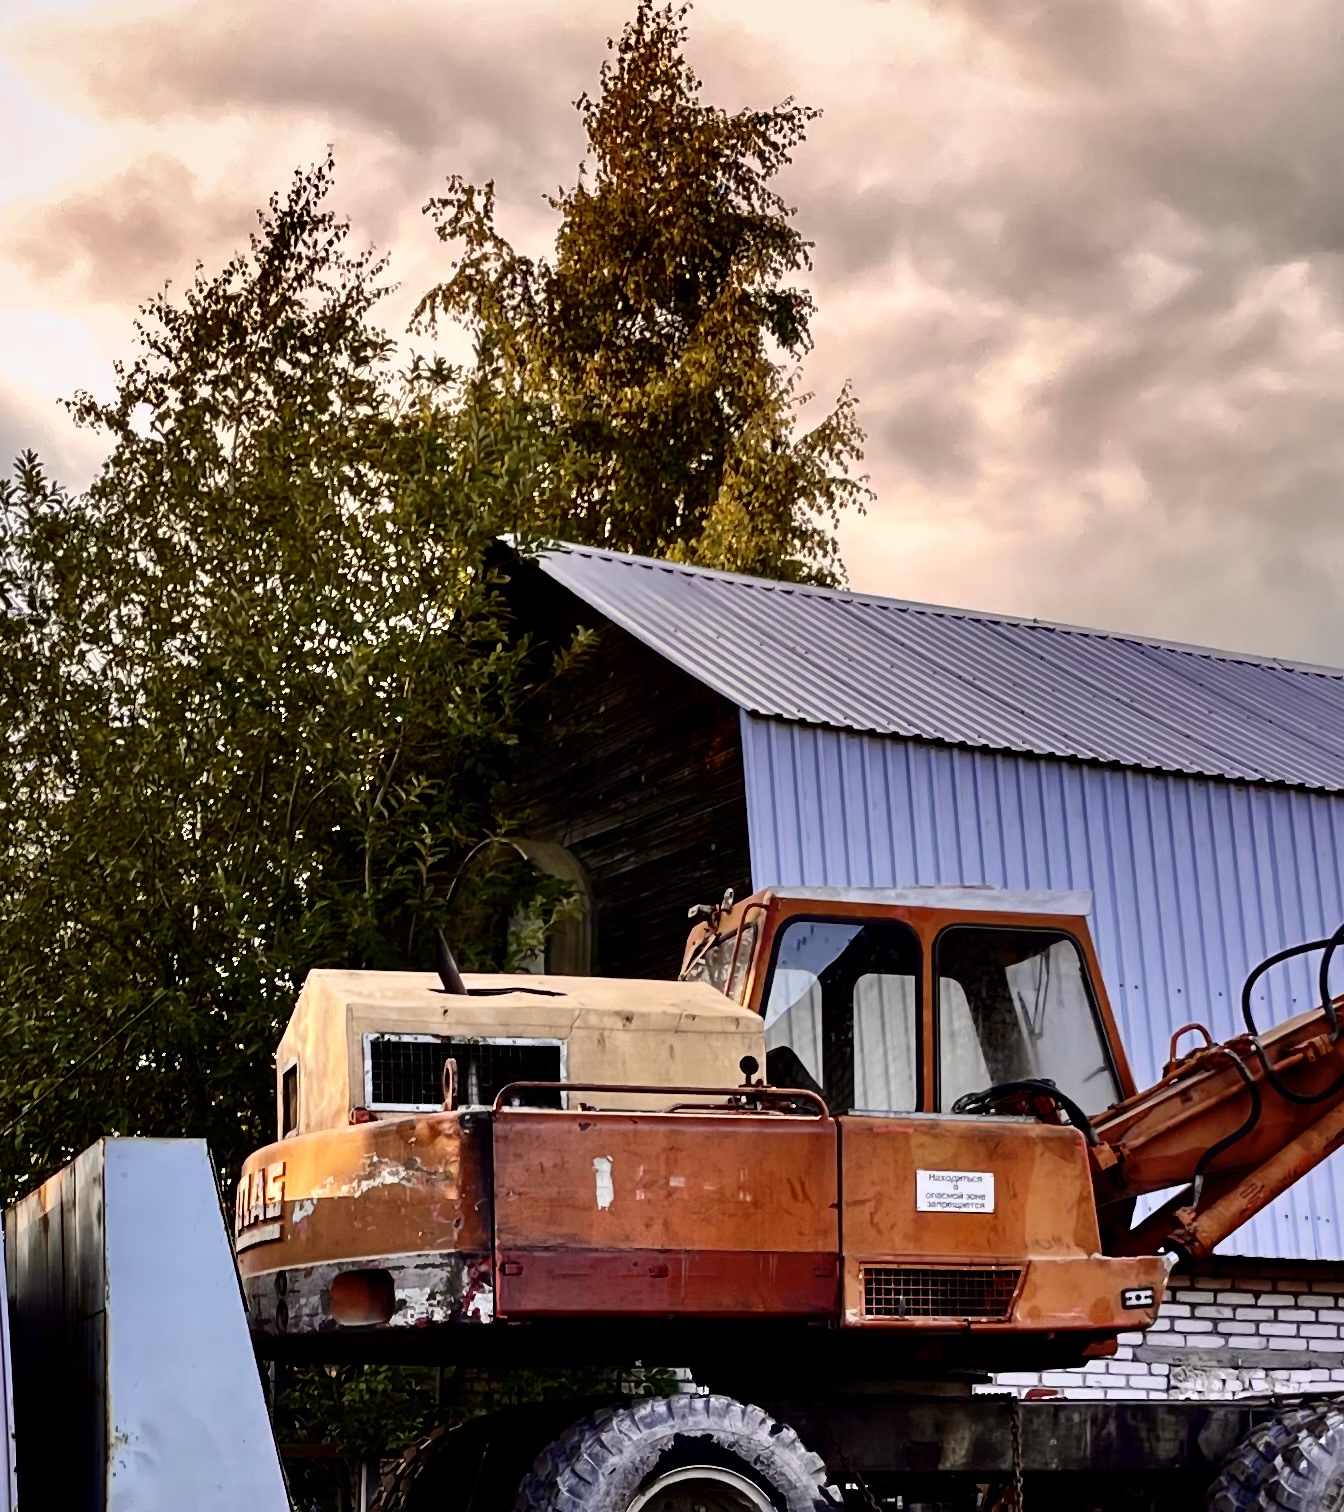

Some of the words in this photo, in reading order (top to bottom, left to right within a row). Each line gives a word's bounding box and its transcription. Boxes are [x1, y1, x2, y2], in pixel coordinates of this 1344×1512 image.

[928, 1173, 983, 1184] Находиться
[236, 1162, 285, 1236] TLAS
[926, 1201, 986, 1210] запрещается
